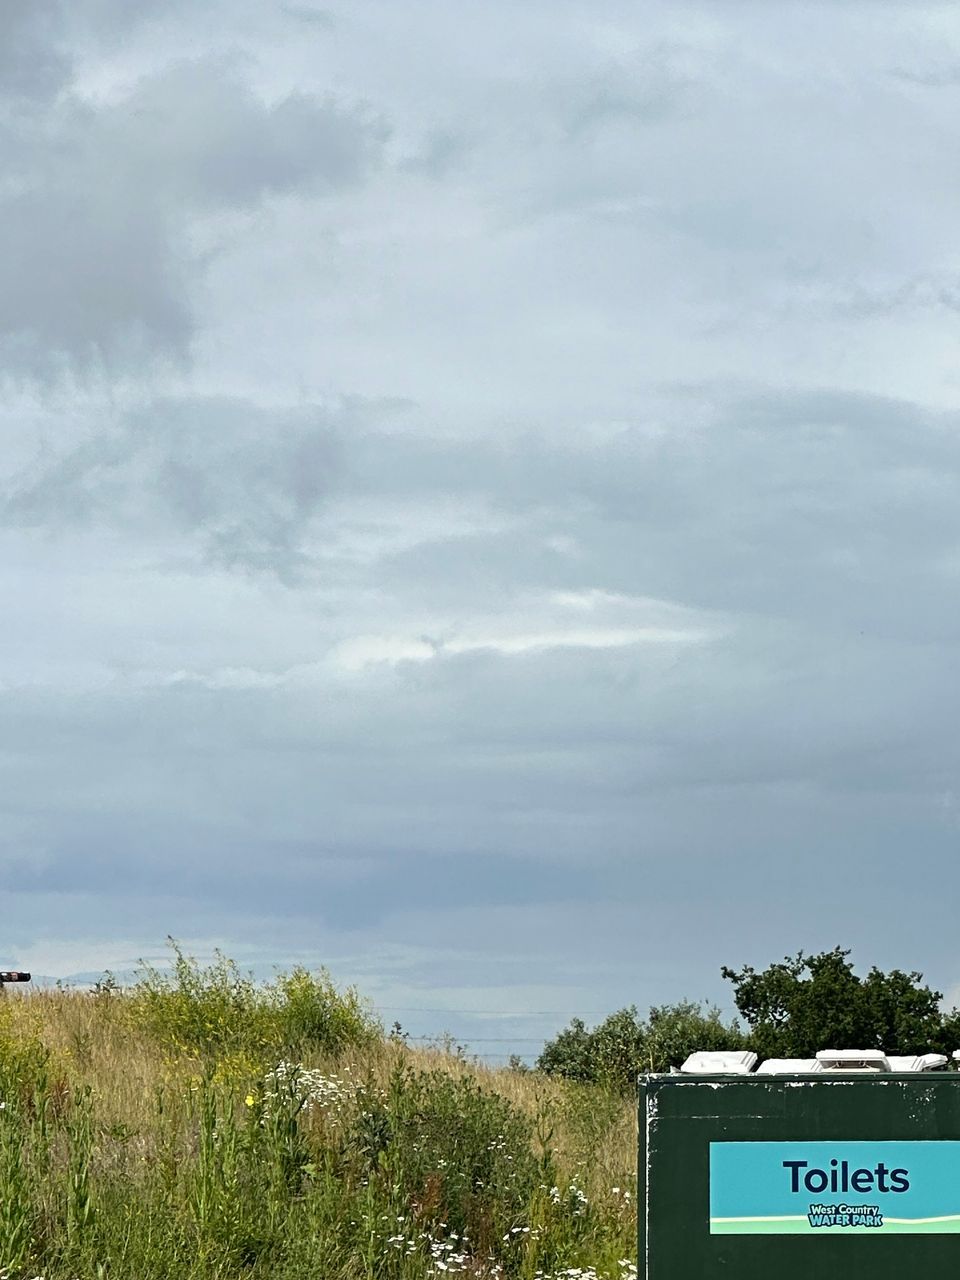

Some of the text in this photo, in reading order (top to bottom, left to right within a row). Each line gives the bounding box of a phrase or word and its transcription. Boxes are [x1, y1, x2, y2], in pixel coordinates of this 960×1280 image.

[783, 1158, 910, 1193] Toilets
[810, 1204, 879, 1216] West Country
[808, 1213, 883, 1227] WATER PARK
